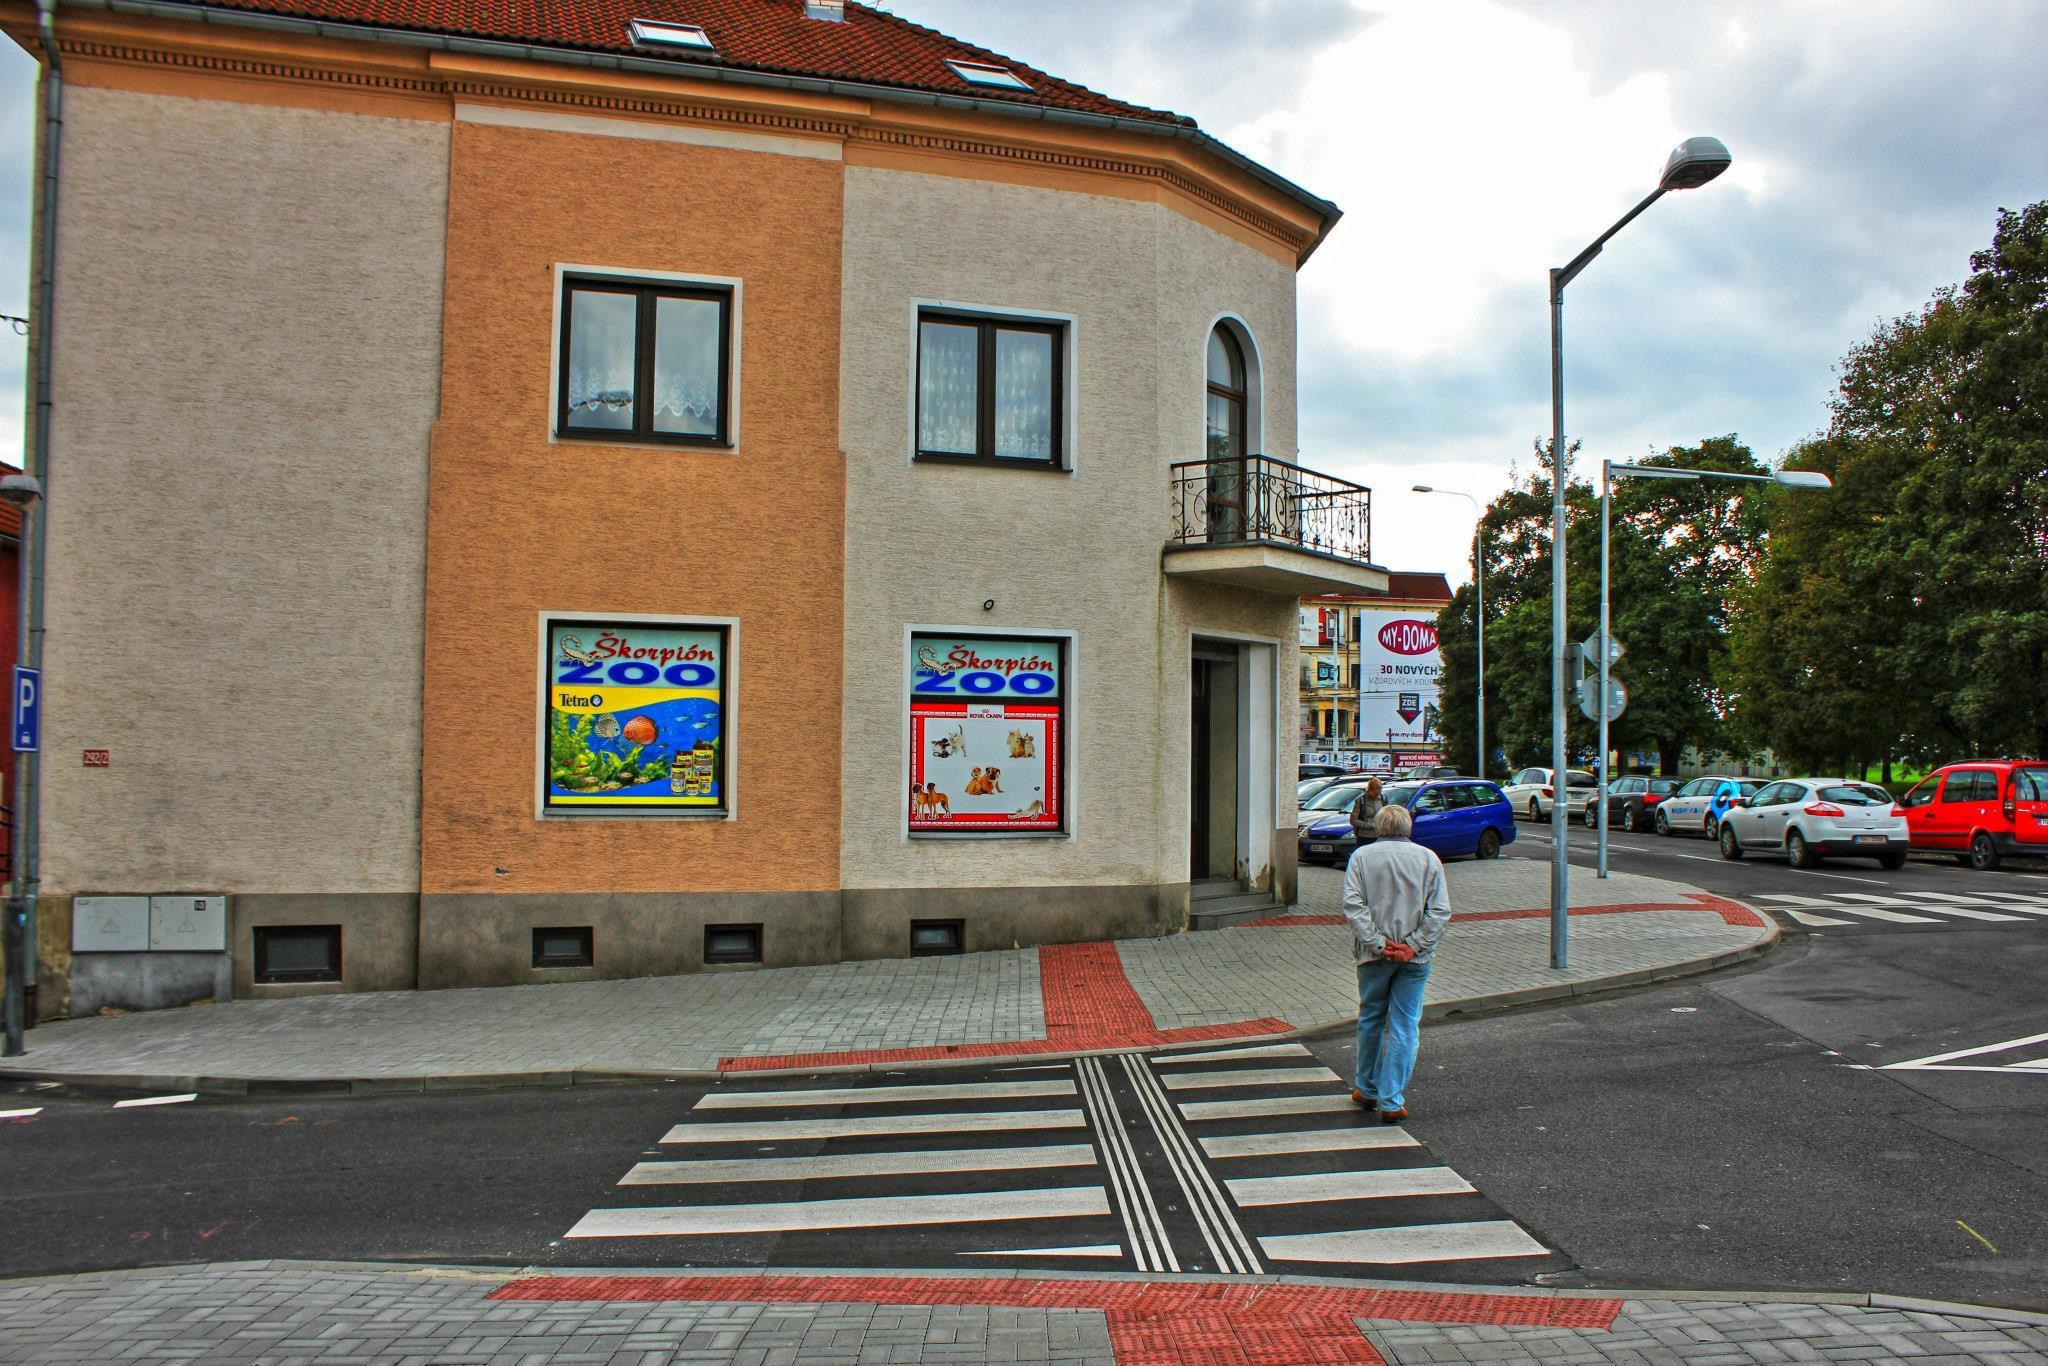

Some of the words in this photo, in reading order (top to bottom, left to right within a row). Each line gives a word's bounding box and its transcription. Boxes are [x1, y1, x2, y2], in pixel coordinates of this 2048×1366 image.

[591, 632, 715, 667] Škorpión
[945, 645, 1054, 676] Škorpión
[558, 660, 716, 686] ZOO
[1380, 664, 1393, 674] 30
[915, 670, 1055, 694] ZOO
[18, 677, 36, 725] P
[559, 693, 590, 707] Tetra
[1402, 699, 1417, 707] ZDE
